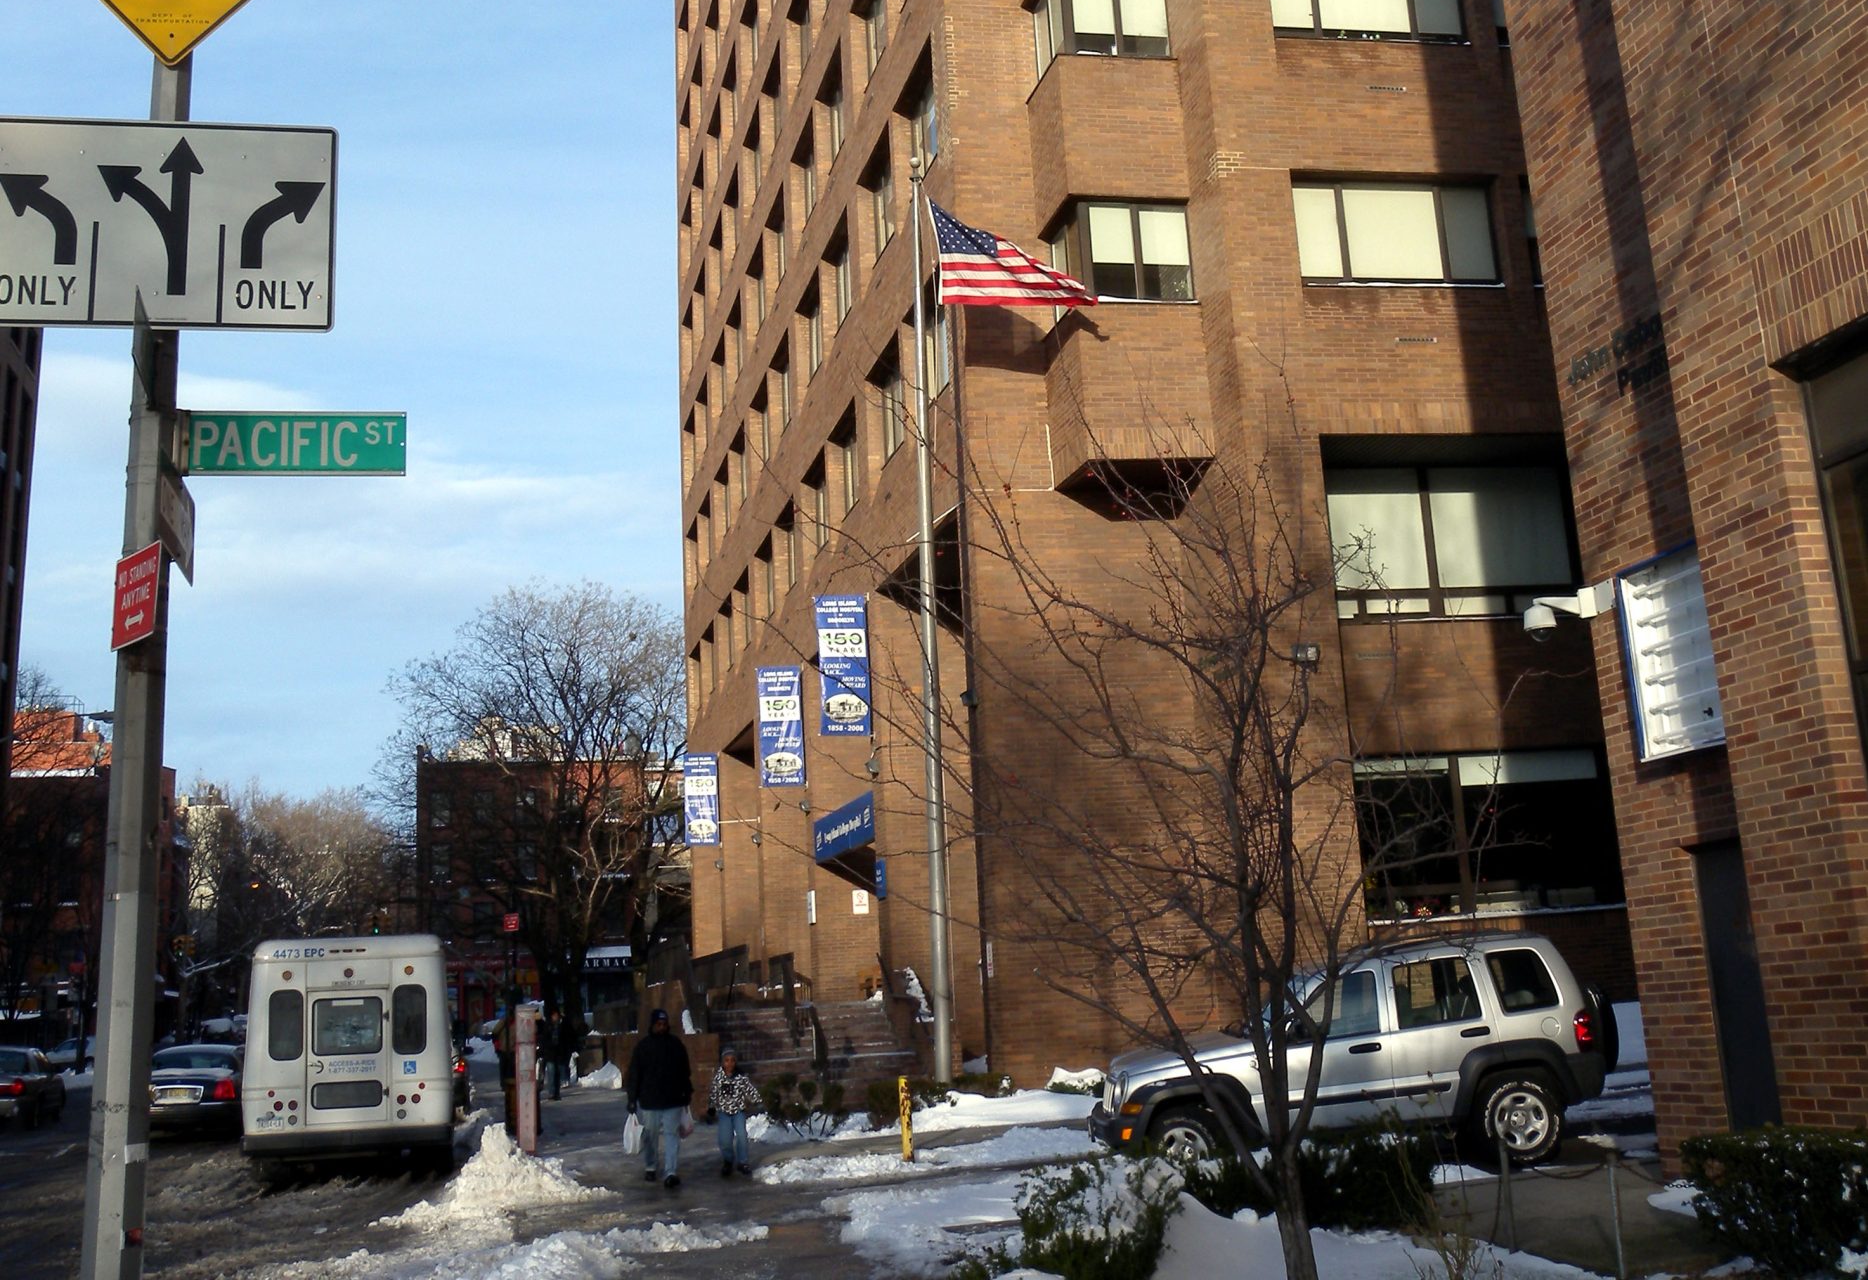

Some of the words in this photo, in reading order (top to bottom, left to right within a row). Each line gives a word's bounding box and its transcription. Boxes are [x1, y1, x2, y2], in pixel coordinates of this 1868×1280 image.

[0, 274, 76, 305] ONLY
[235, 279, 314, 310] ONLY
[192, 421, 359, 467] PACIFIC
[364, 421, 397, 445] ST
[118, 571, 127, 590] NO
[130, 556, 157, 583] STANDING
[121, 582, 151, 611] ANYTIME
[825, 632, 863, 645] 150
[765, 699, 796, 711] 150
[273, 949, 300, 959] 4473
[304, 948, 325, 958] EPC
